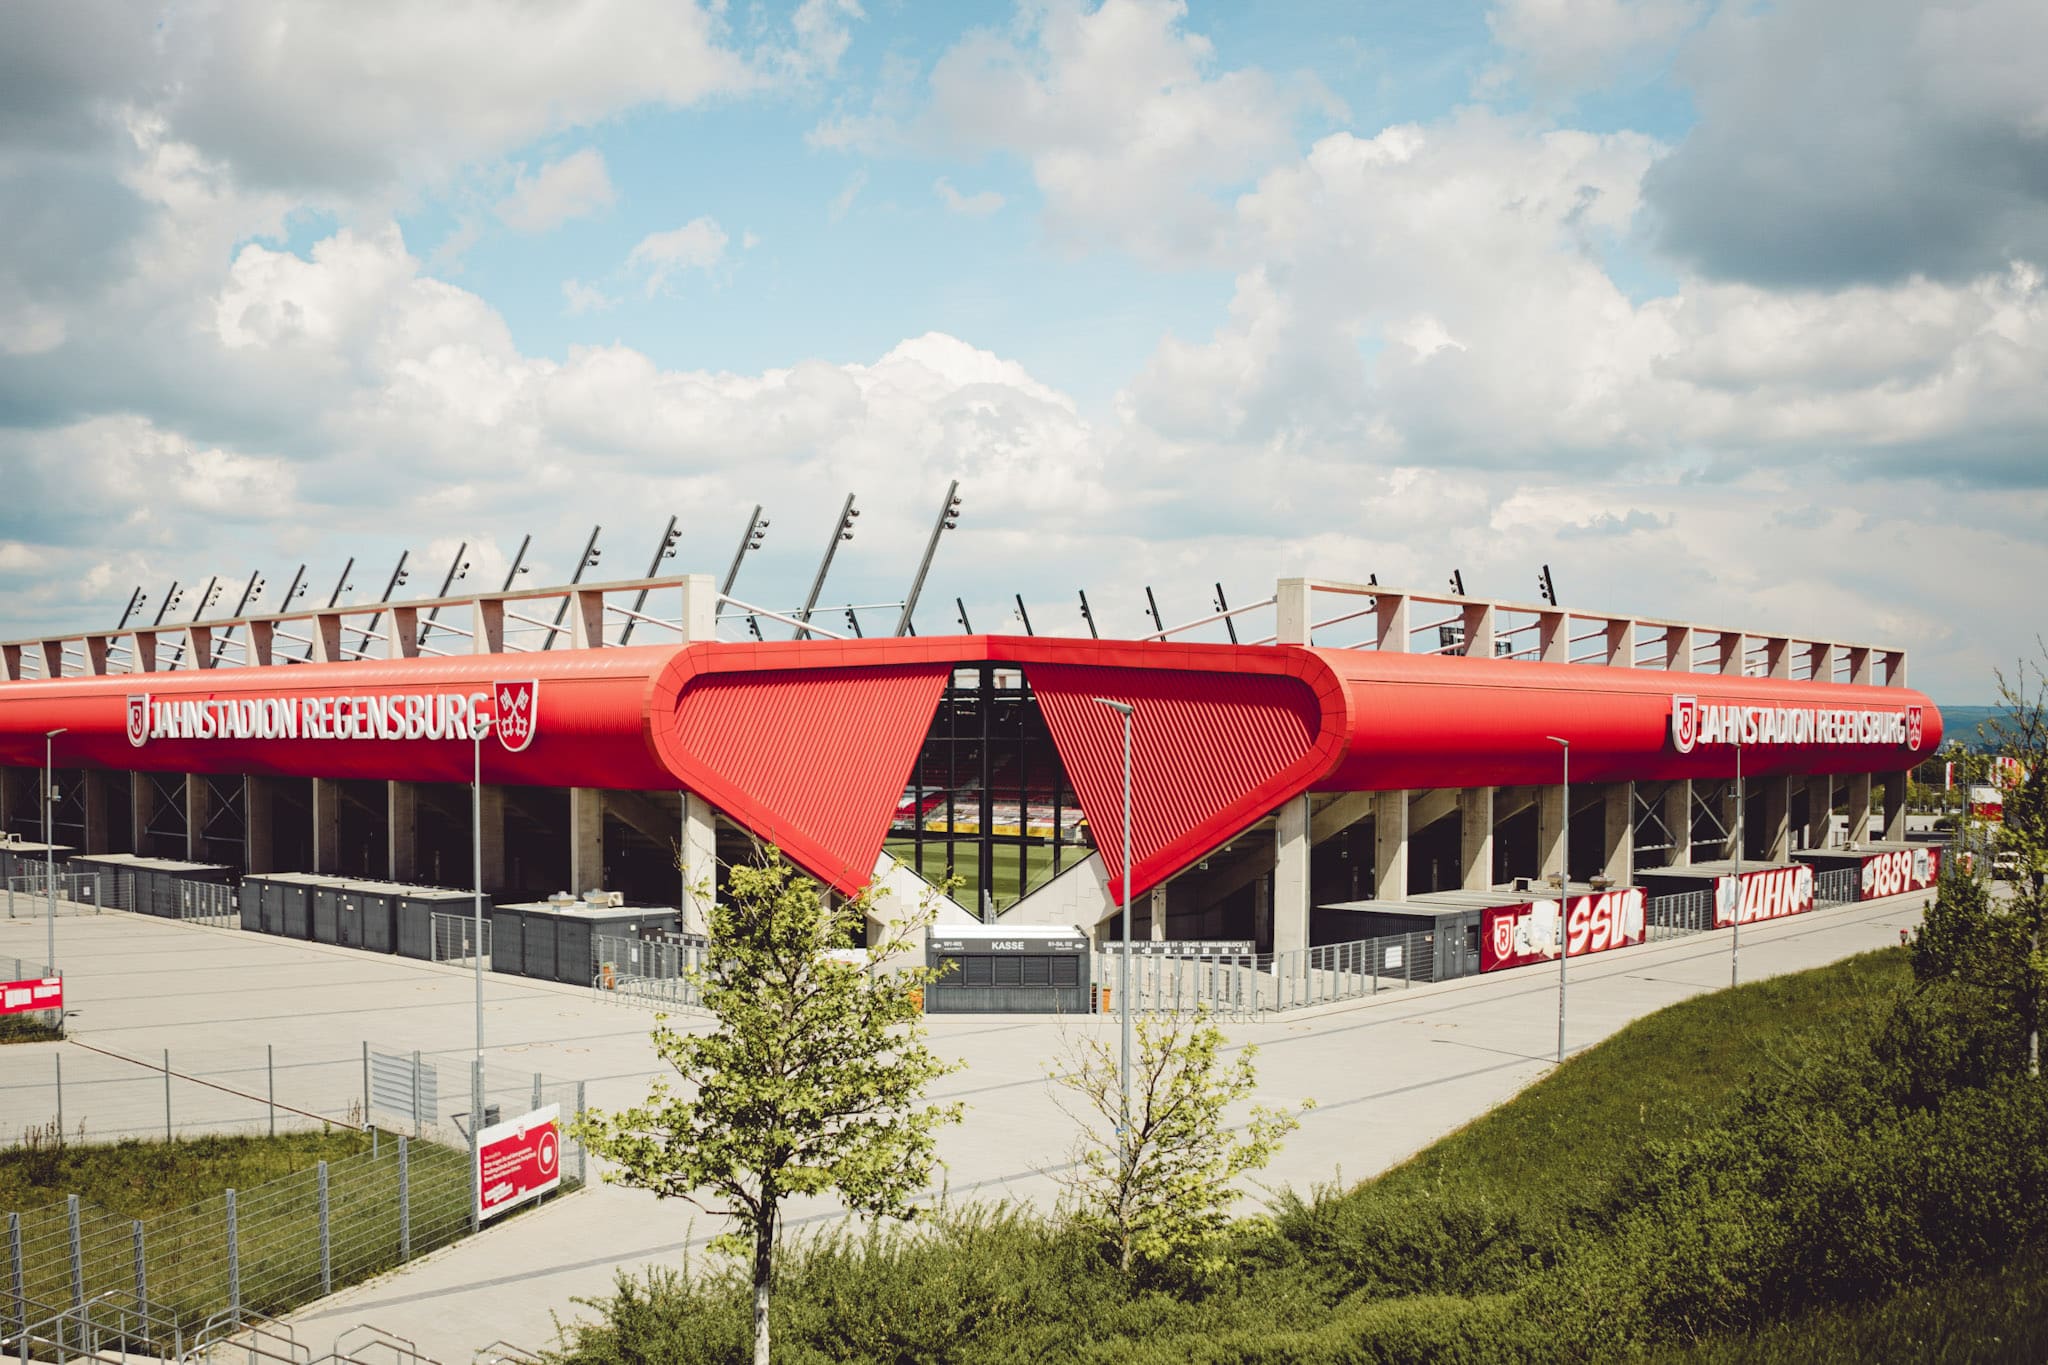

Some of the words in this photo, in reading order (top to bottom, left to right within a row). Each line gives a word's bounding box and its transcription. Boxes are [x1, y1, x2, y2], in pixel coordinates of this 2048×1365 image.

[150, 696, 298, 739] JAHNSTADION
[302, 692, 491, 740] REGENSBURG
[1697, 704, 1815, 744] JAHNSTADION
[1817, 709, 1906, 744] REGENSBURG
[1873, 850, 1912, 897] 1889
[991, 941, 1025, 950] KASSE
[1568, 890, 1631, 954] SSV
